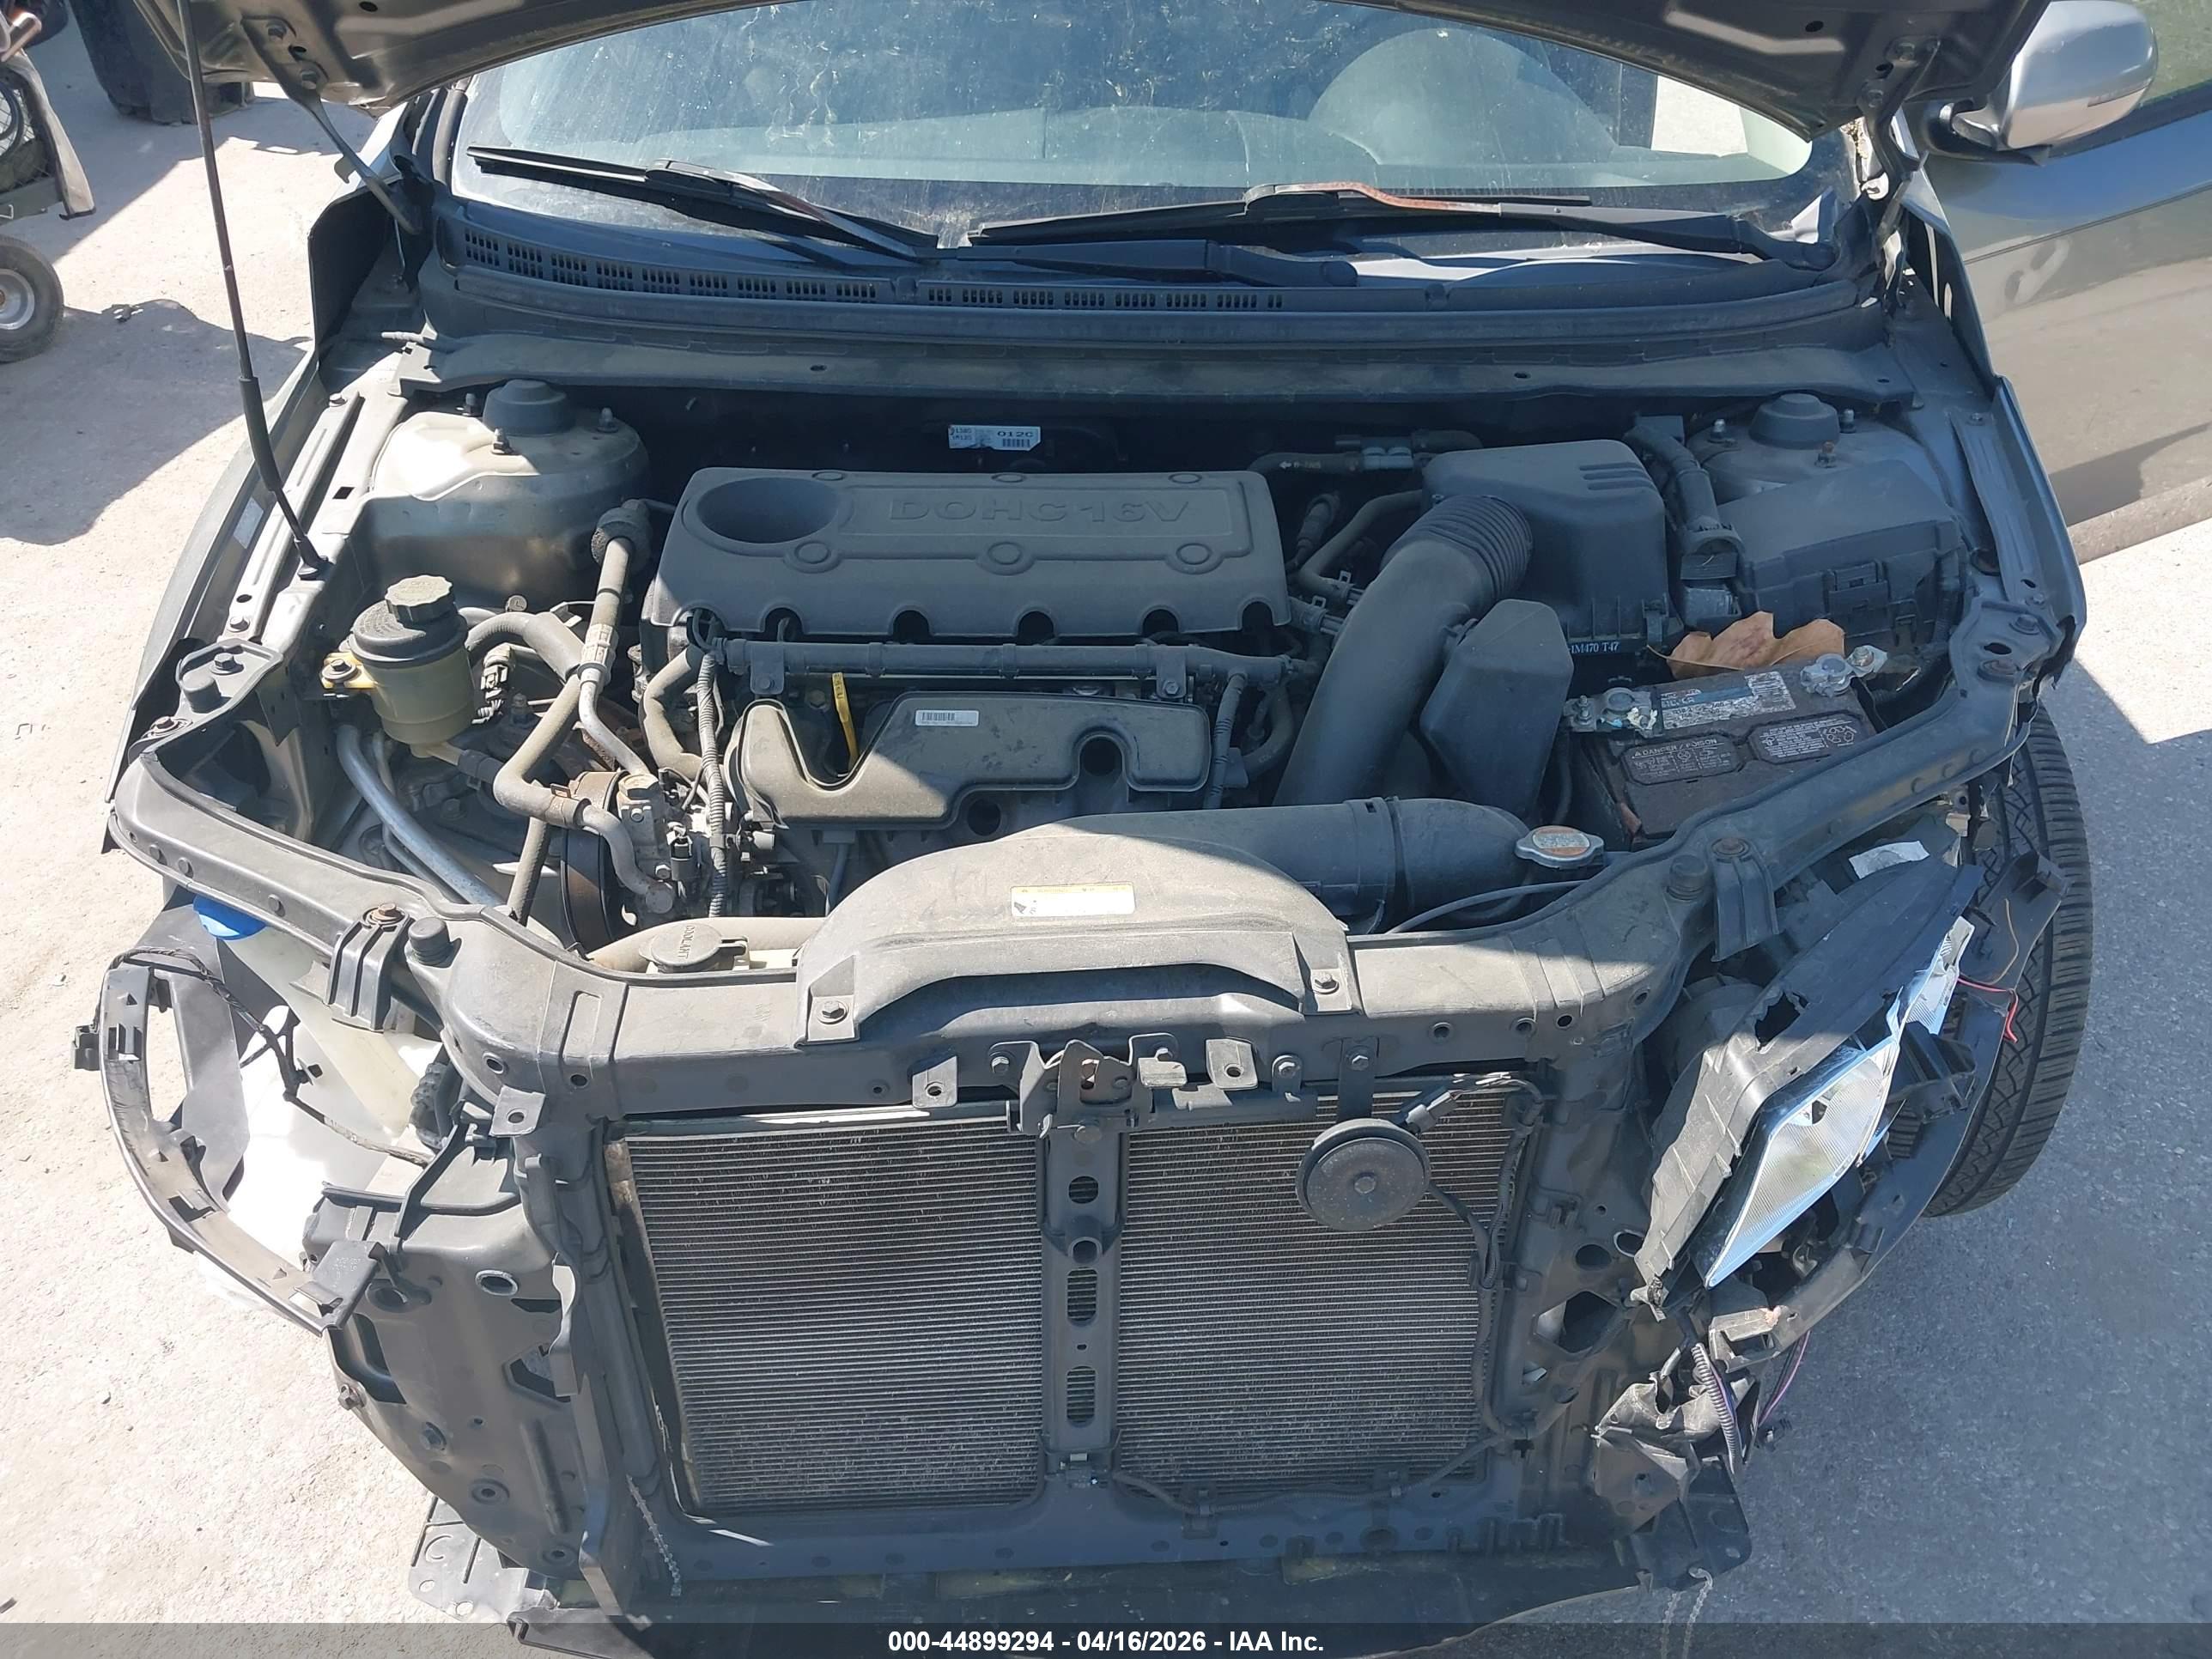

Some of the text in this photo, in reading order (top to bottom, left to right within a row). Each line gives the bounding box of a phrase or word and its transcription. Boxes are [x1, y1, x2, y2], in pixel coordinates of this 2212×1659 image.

[890, 499, 1190, 523] DOHC 16V
[1642, 744, 1678, 757] DANGER
[1686, 738, 1717, 749] POISON
[677, 925, 696, 959] COOLANT
